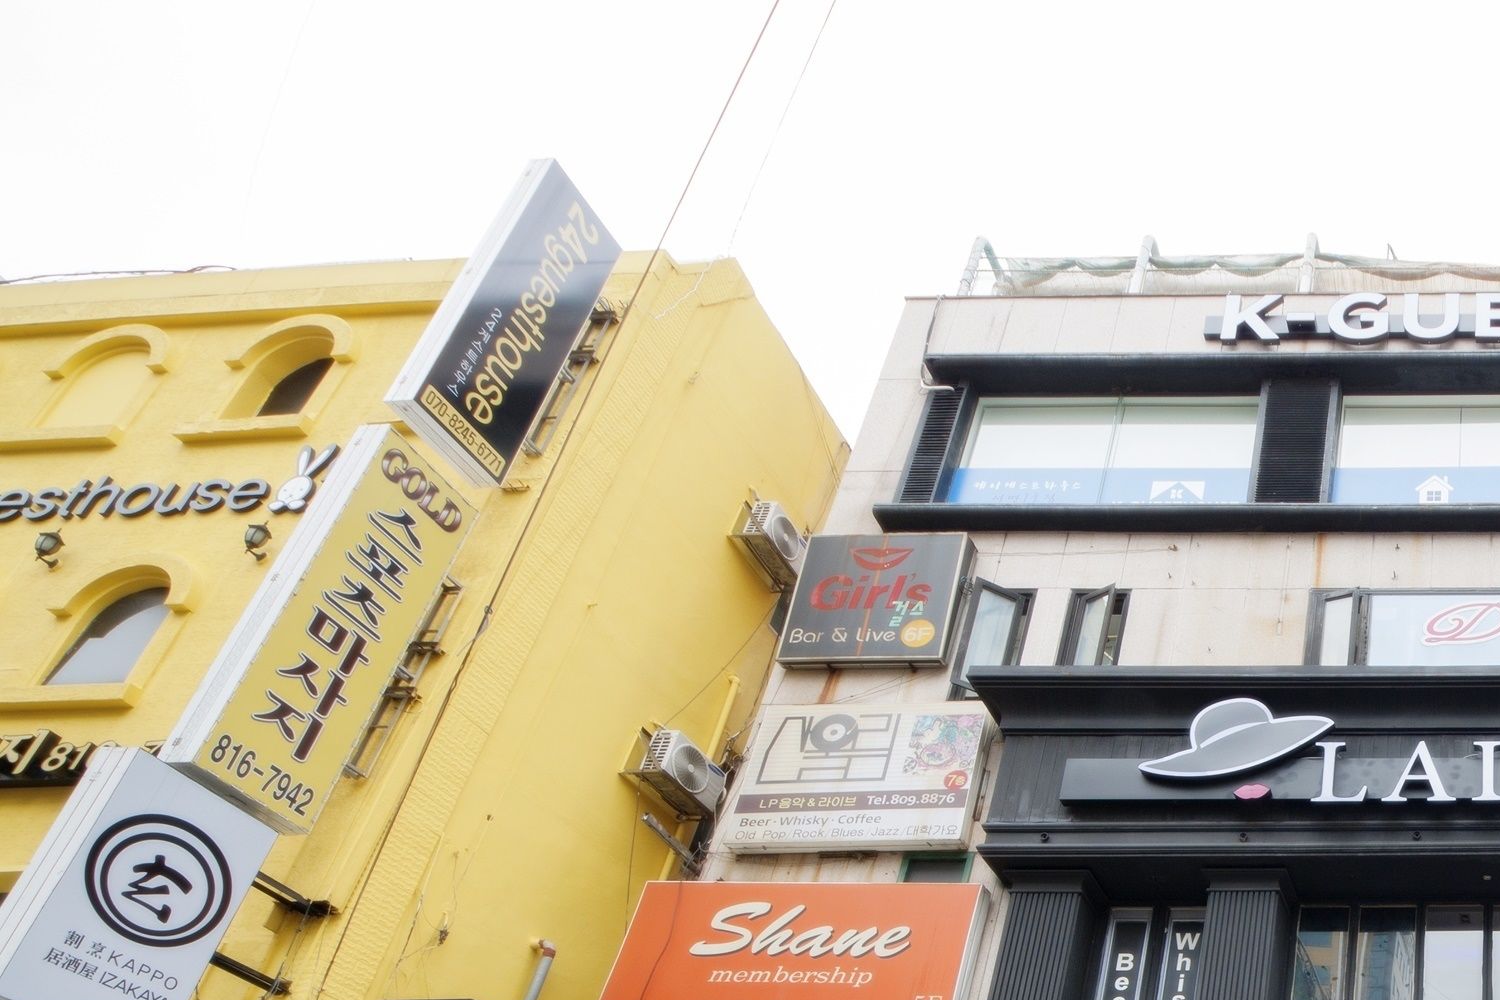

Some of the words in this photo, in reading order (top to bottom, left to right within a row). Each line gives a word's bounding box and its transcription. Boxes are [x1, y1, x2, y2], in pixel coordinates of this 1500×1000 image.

[465, 201, 599, 425] 24guesthouse
[425, 391, 502, 472] 070-8245-6771
[381, 448, 462, 533] GOLD
[810, 573, 932, 611] Girl's
[889, 601, 925, 627] 걸스
[789, 628, 824, 643] Bar
[831, 627, 848, 642] &
[856, 627, 896, 642] Live
[903, 627, 934, 643] 6F
[210, 734, 315, 817] 816-7942
[867, 793, 956, 806] Tel.809.8876
[735, 830, 756, 841] Old
[740, 816, 771, 828] Beer
[779, 815, 829, 827] Whisky
[838, 814, 882, 825] Coffee
[688, 902, 912, 960] Shane
[108, 950, 179, 992] KAPPO
[707, 966, 873, 986] membership
